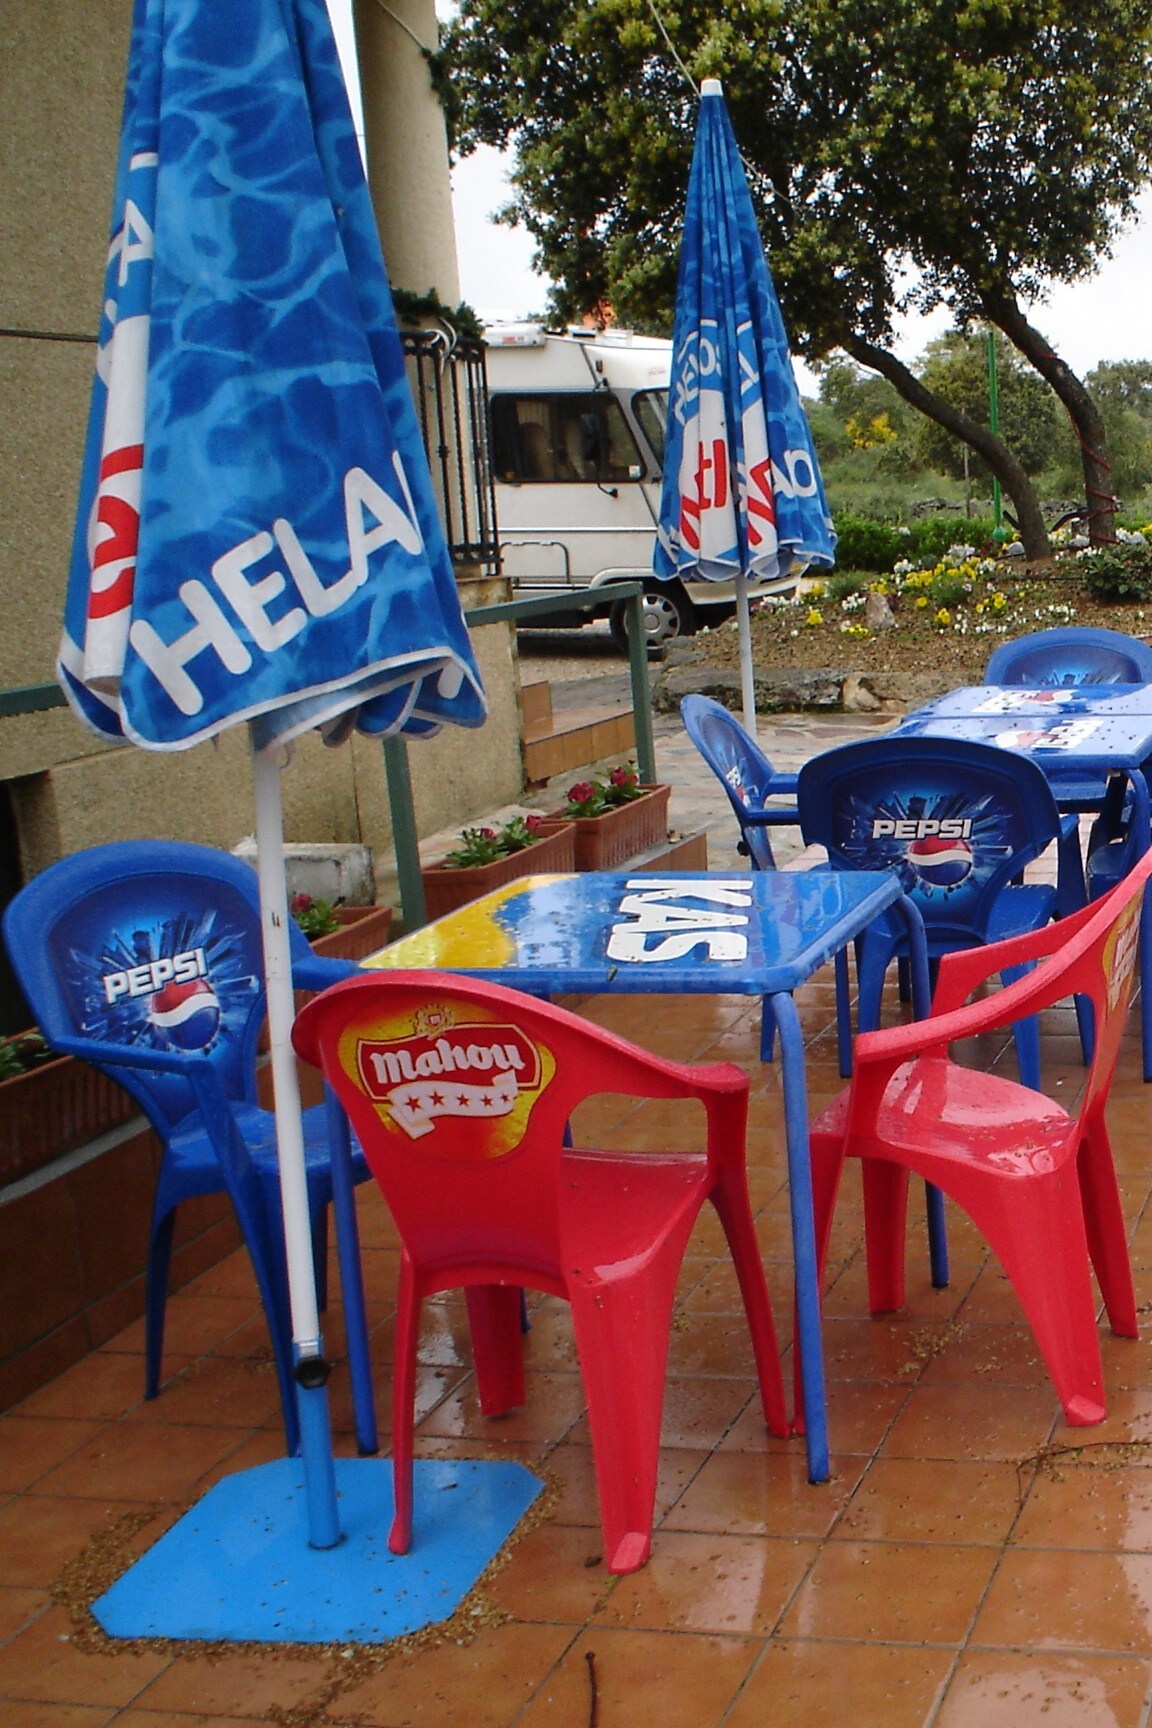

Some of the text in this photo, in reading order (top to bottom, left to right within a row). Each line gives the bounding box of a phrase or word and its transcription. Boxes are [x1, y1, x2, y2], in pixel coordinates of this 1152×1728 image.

[129, 451, 423, 716] HELA
[870, 817, 974, 841] PEPSI
[605, 878, 755, 963] KAS
[102, 947, 208, 1005] PEPSI
